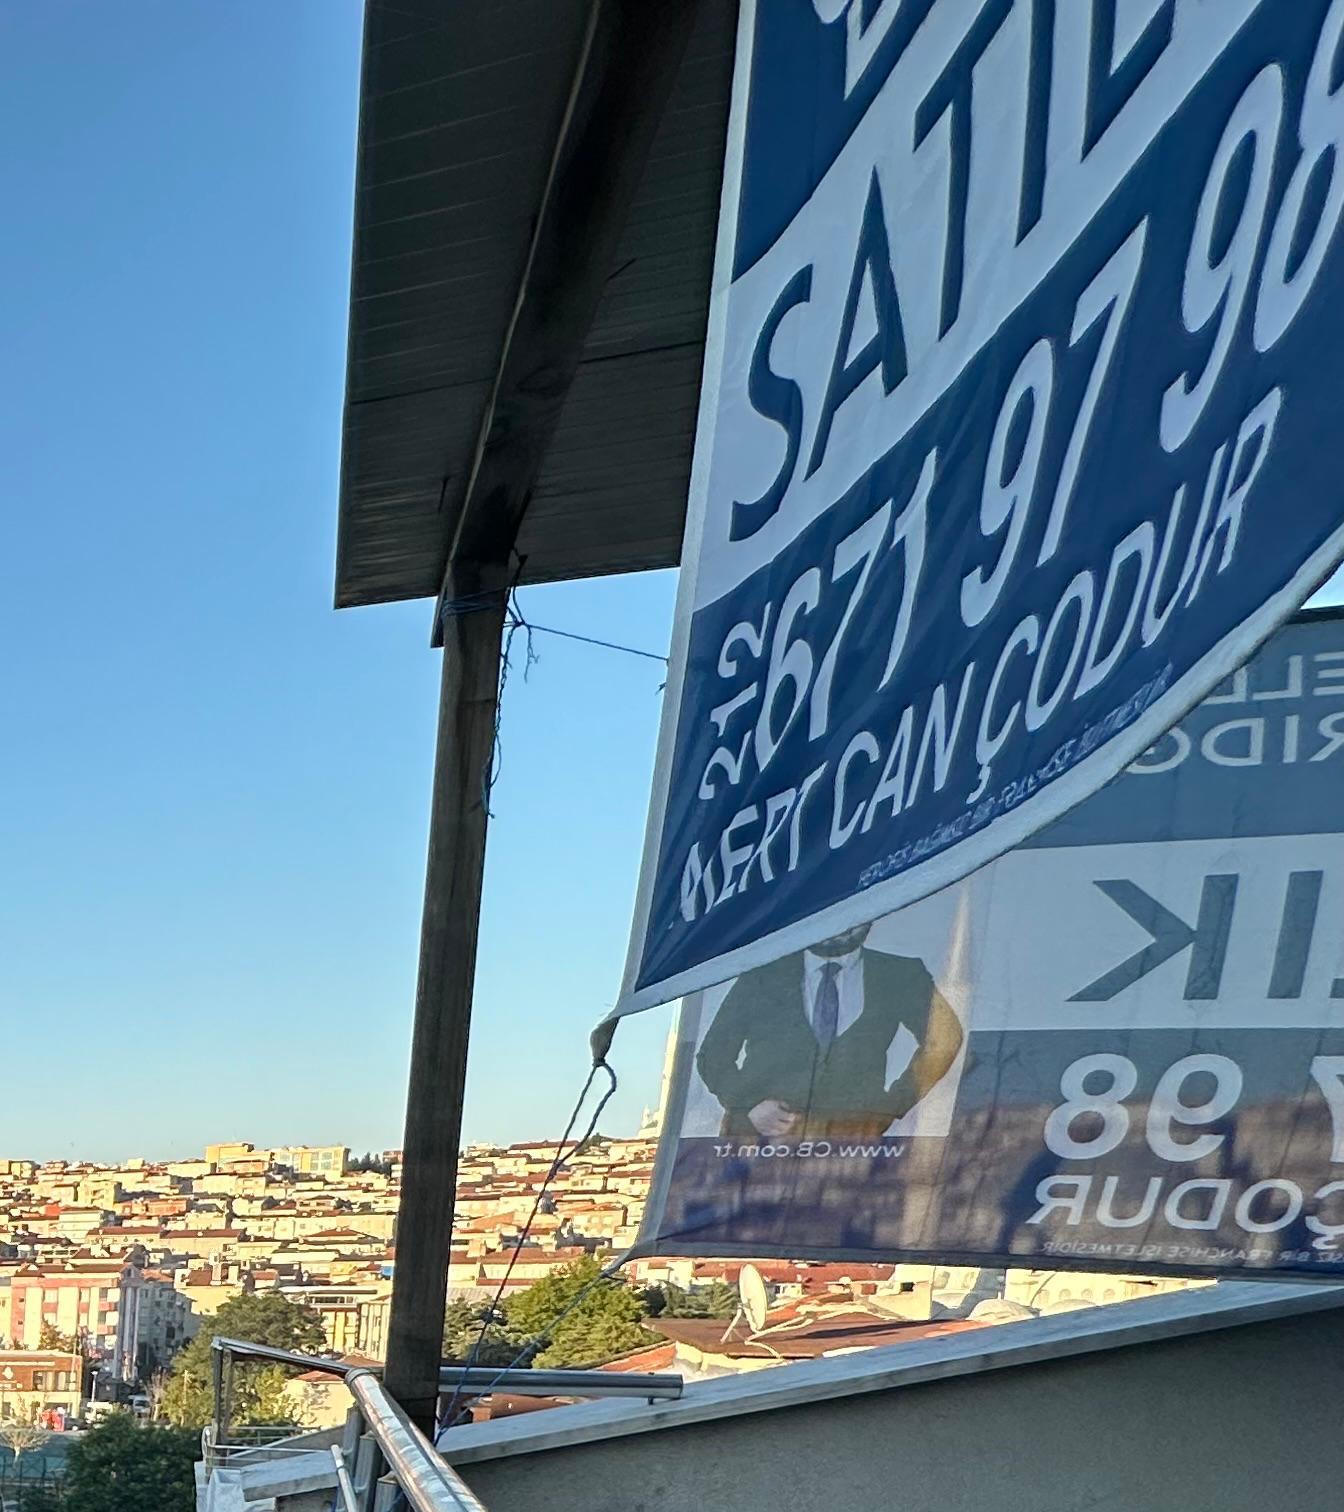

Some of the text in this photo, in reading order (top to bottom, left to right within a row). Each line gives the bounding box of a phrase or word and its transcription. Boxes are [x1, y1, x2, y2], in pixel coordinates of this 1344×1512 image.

[699, 602, 772, 800] 212
[754, 446, 938, 773] 671
[960, 214, 1148, 628] 97
[828, 661, 976, 850] CAN
[966, 386, 1283, 805] ÇODUR
